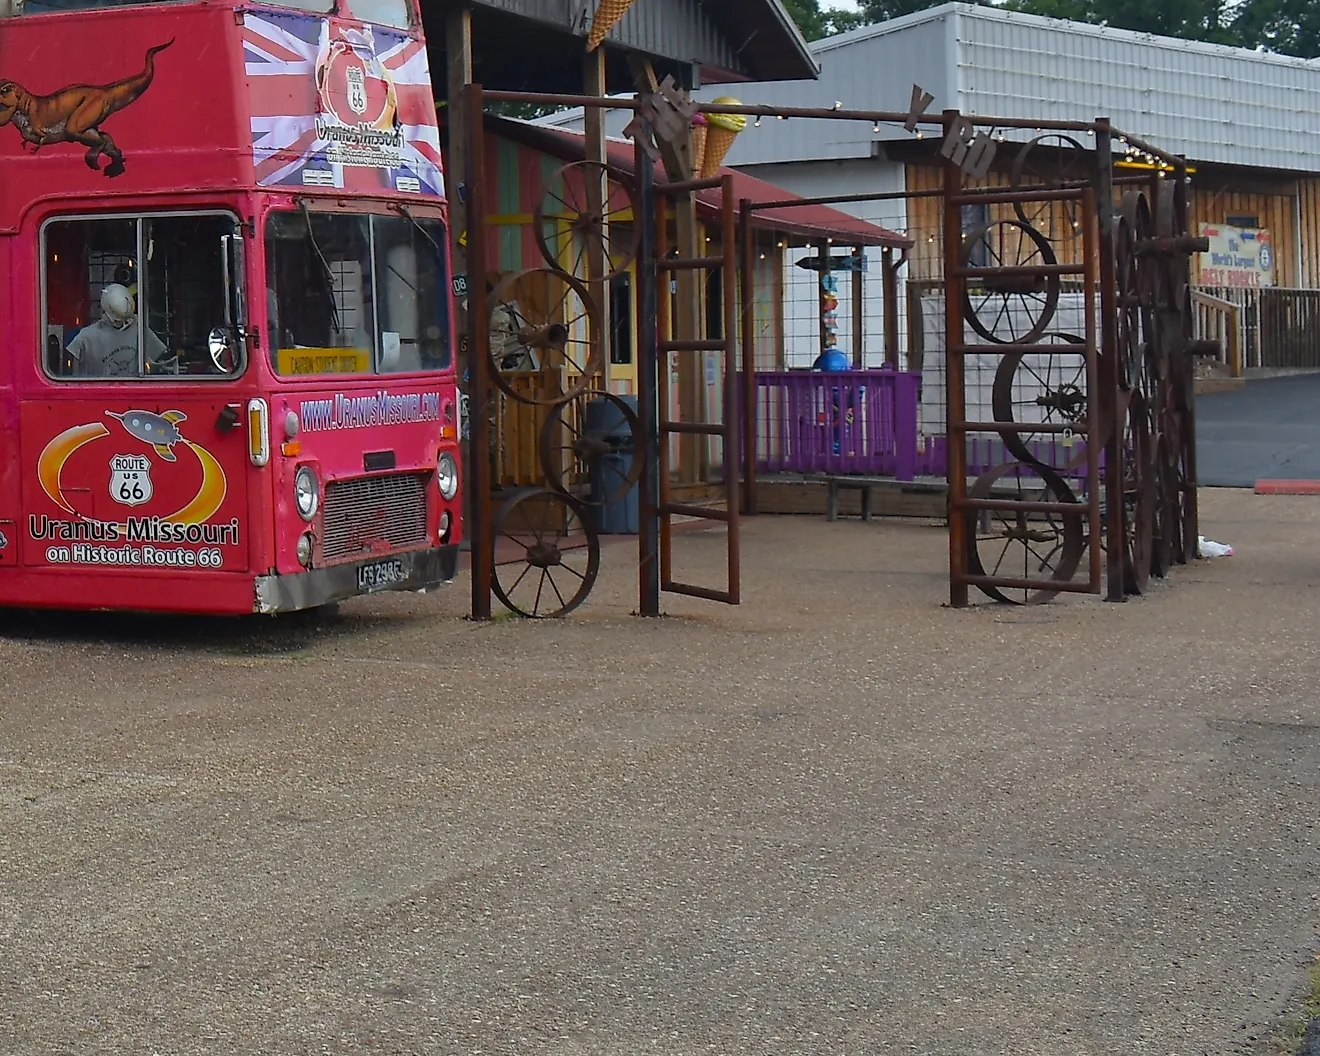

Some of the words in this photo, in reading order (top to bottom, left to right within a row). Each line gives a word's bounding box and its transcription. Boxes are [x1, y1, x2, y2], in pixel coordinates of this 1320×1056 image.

[352, 92, 363, 108] 66
[115, 458, 145, 470] ROUTE
[119, 482, 145, 500] 66
[29, 514, 120, 541] Uranus
[126, 516, 239, 545] Missouri
[46, 546, 69, 562] on
[72, 544, 140, 564] Historic
[143, 547, 195, 566] Route
[197, 549, 224, 567] 66
